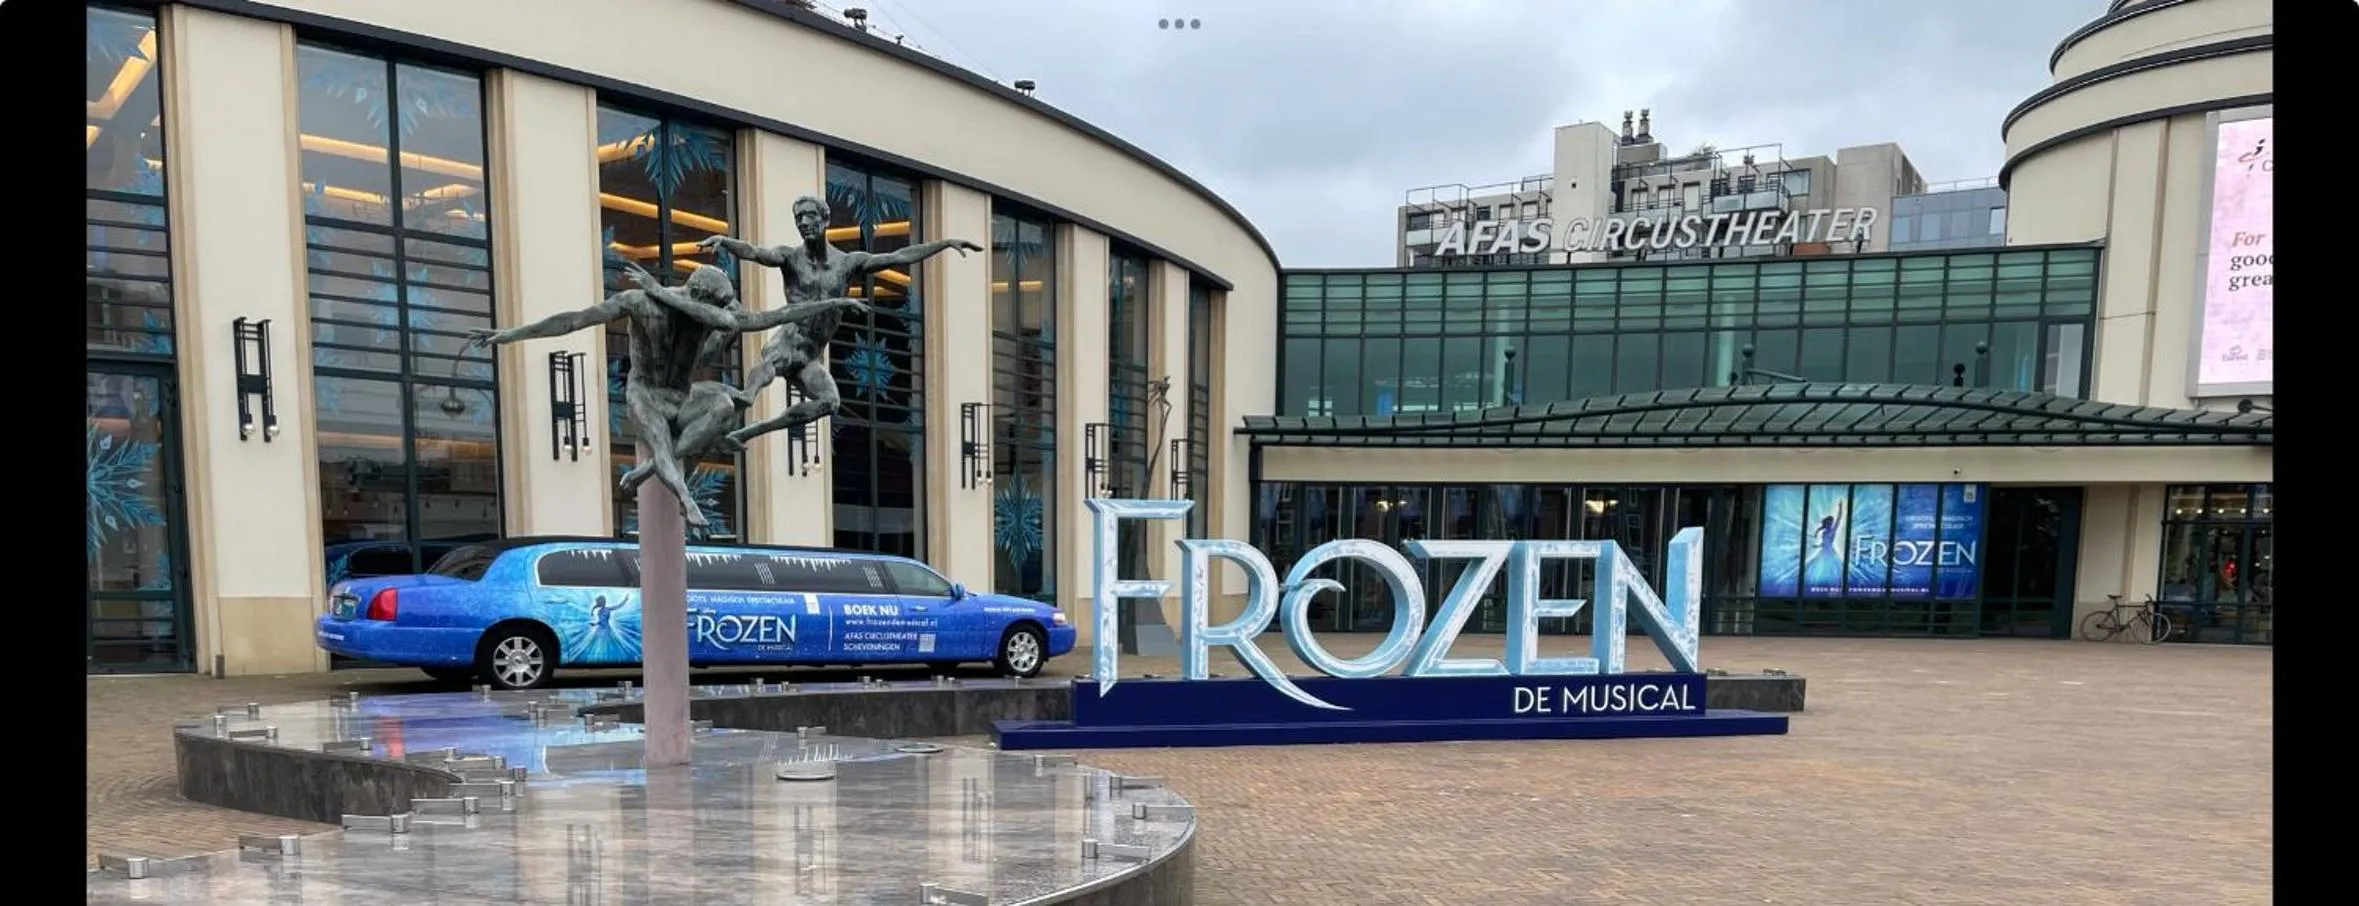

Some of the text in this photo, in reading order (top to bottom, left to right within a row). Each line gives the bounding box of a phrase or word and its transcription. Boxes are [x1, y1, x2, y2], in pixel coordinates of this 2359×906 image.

[1434, 206, 1878, 256] AFAS CIRCUSTHEATER
[2232, 231, 2266, 247] For
[1855, 534, 1977, 572] FROZEN
[843, 604, 899, 616] BOEK NU
[1084, 498, 1705, 711] FROZEN
[843, 643, 901, 651] SCHEVENINGEN
[844, 632, 864, 640] AFAS
[1514, 683, 1697, 714] DE MUSICAL
